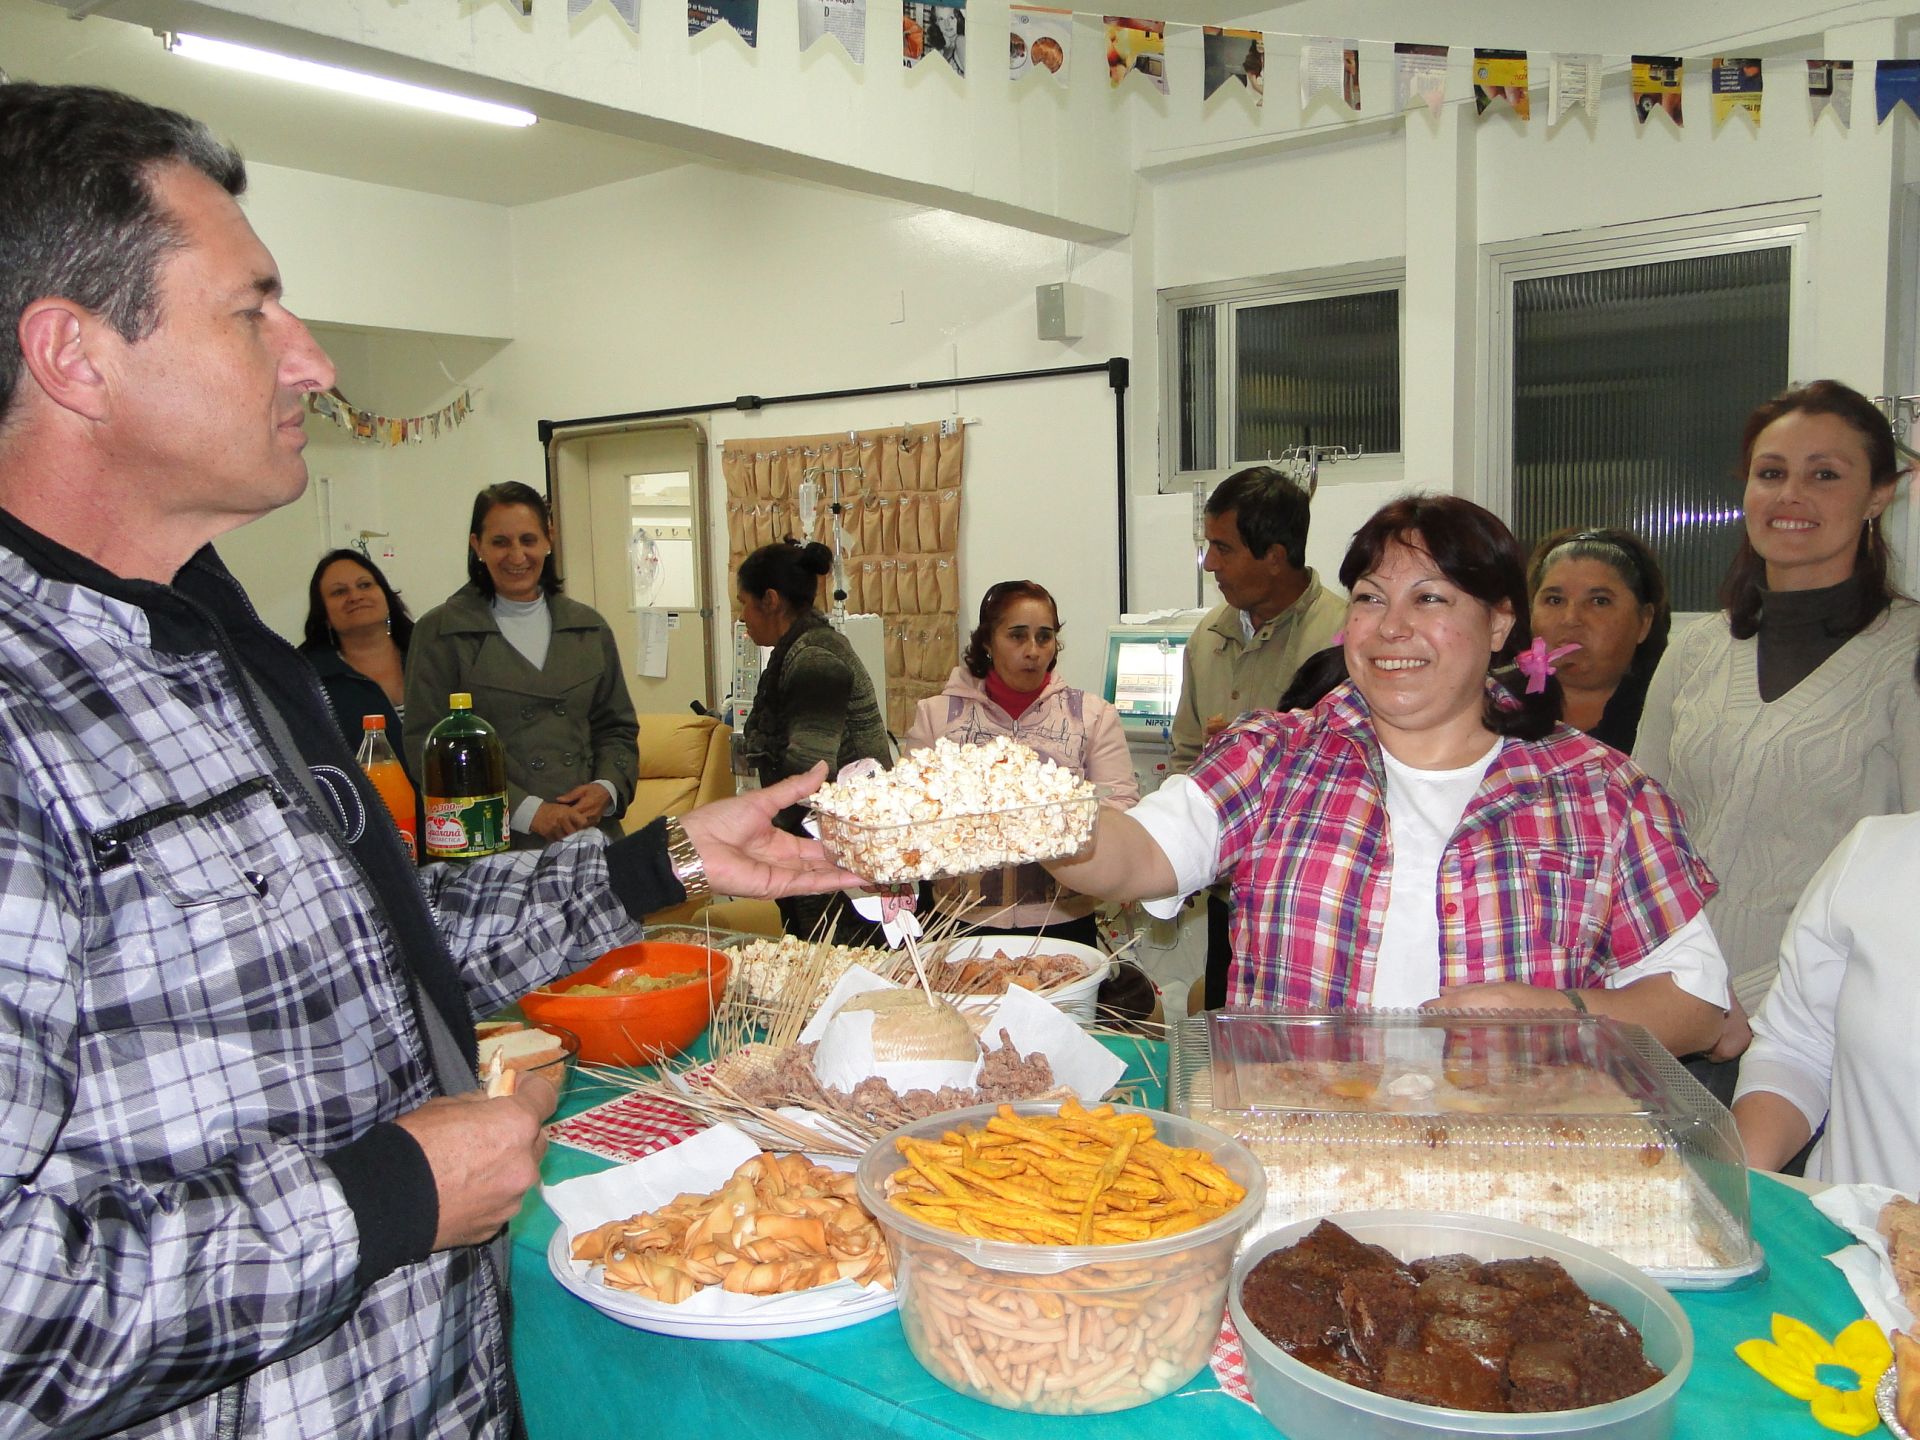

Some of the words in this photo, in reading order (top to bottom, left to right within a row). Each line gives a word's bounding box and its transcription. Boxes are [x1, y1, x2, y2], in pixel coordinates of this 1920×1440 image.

[698, 4, 719, 15] tenha
[824, 6, 830, 17] D
[1145, 719, 1171, 727] NIPRO
